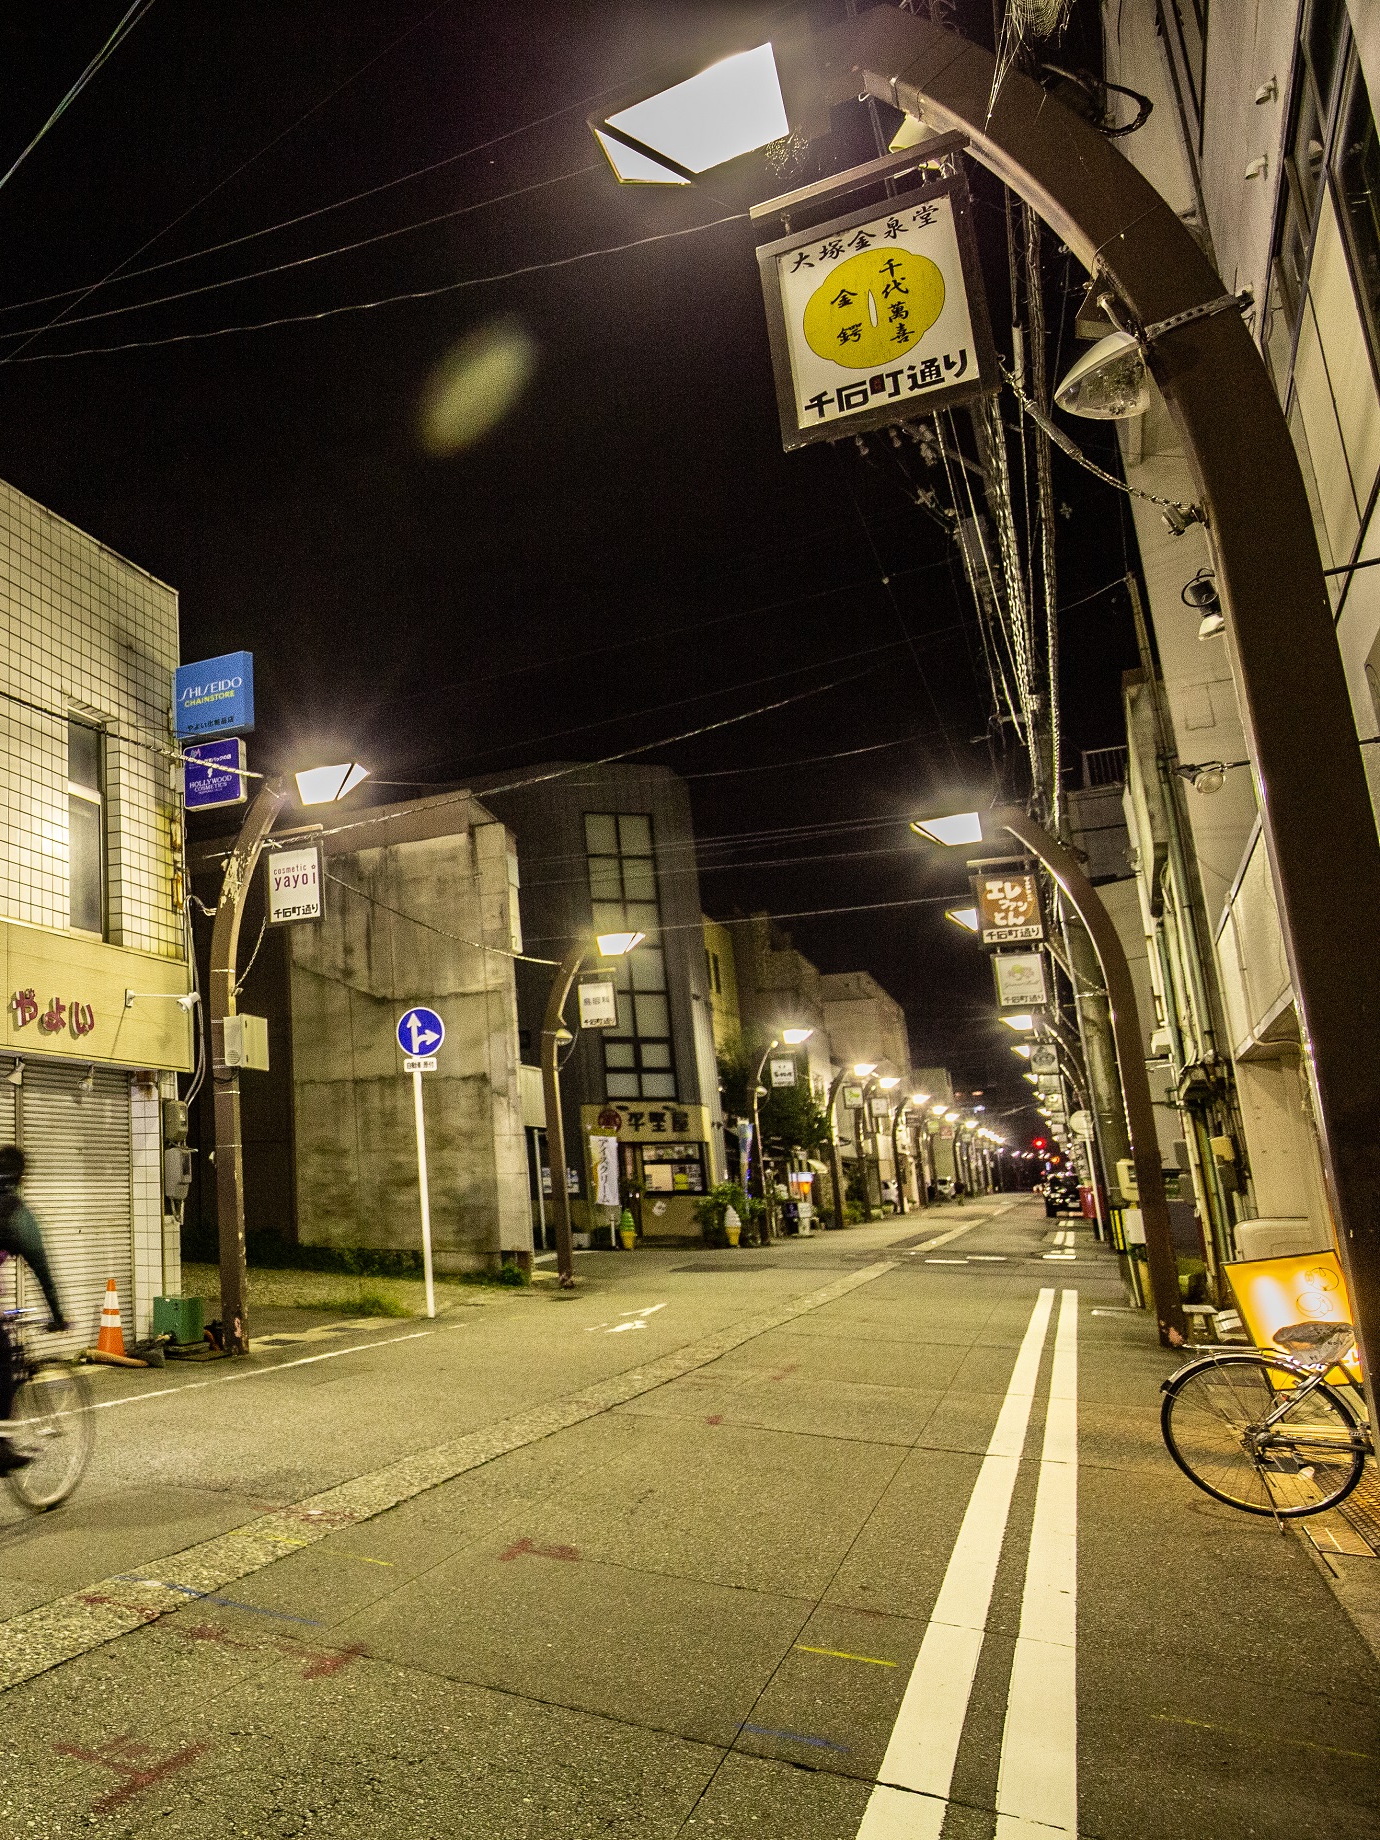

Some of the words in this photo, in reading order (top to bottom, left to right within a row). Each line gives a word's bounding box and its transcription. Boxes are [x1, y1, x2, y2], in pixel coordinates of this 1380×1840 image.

[789, 204, 939, 274] 大塚金泉堂
[878, 258, 915, 345] 千代萬喜
[804, 348, 968, 419] 千石町通り
[179, 676, 243, 702] SHISEIDO
[184, 690, 235, 708] CHAINSTORE
[189, 775, 232, 789] HOLLYWOOD
[194, 782, 227, 793] COSMETICS
[273, 863, 307, 876] cosmetic
[274, 868, 317, 891] yayoi
[985, 880, 1022, 900] エレ
[273, 902, 319, 919] 千石町通り
[994, 911, 1025, 926] とん
[986, 927, 1040, 940] 千石町通り
[1004, 993, 1044, 1004] 千石町通り
[12, 988, 95, 1035] やよい
[598, 1139, 611, 1203] アイスクリーム
